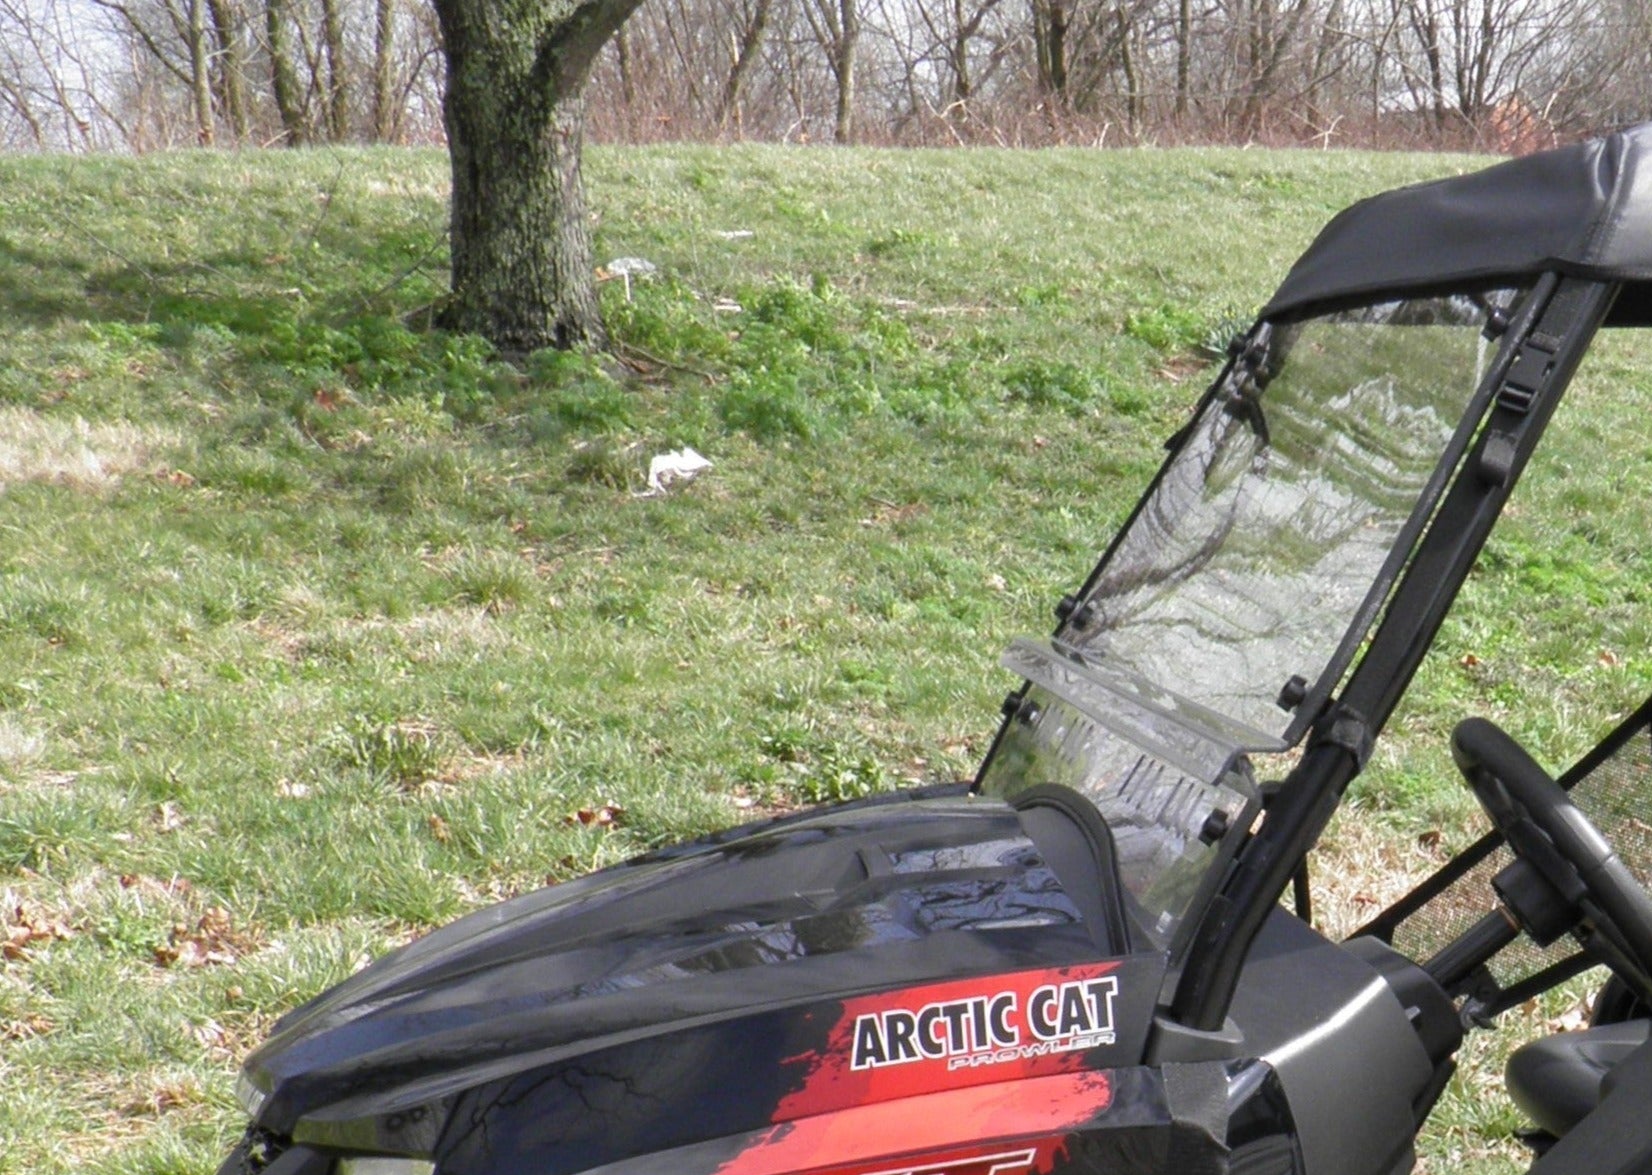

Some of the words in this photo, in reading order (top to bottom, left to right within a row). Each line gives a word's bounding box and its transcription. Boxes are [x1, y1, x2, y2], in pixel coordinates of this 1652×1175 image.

[850, 991, 1018, 1071] ARCTIC
[1027, 976, 1118, 1040] CAT
[947, 1031, 1115, 1071] PROWLER
